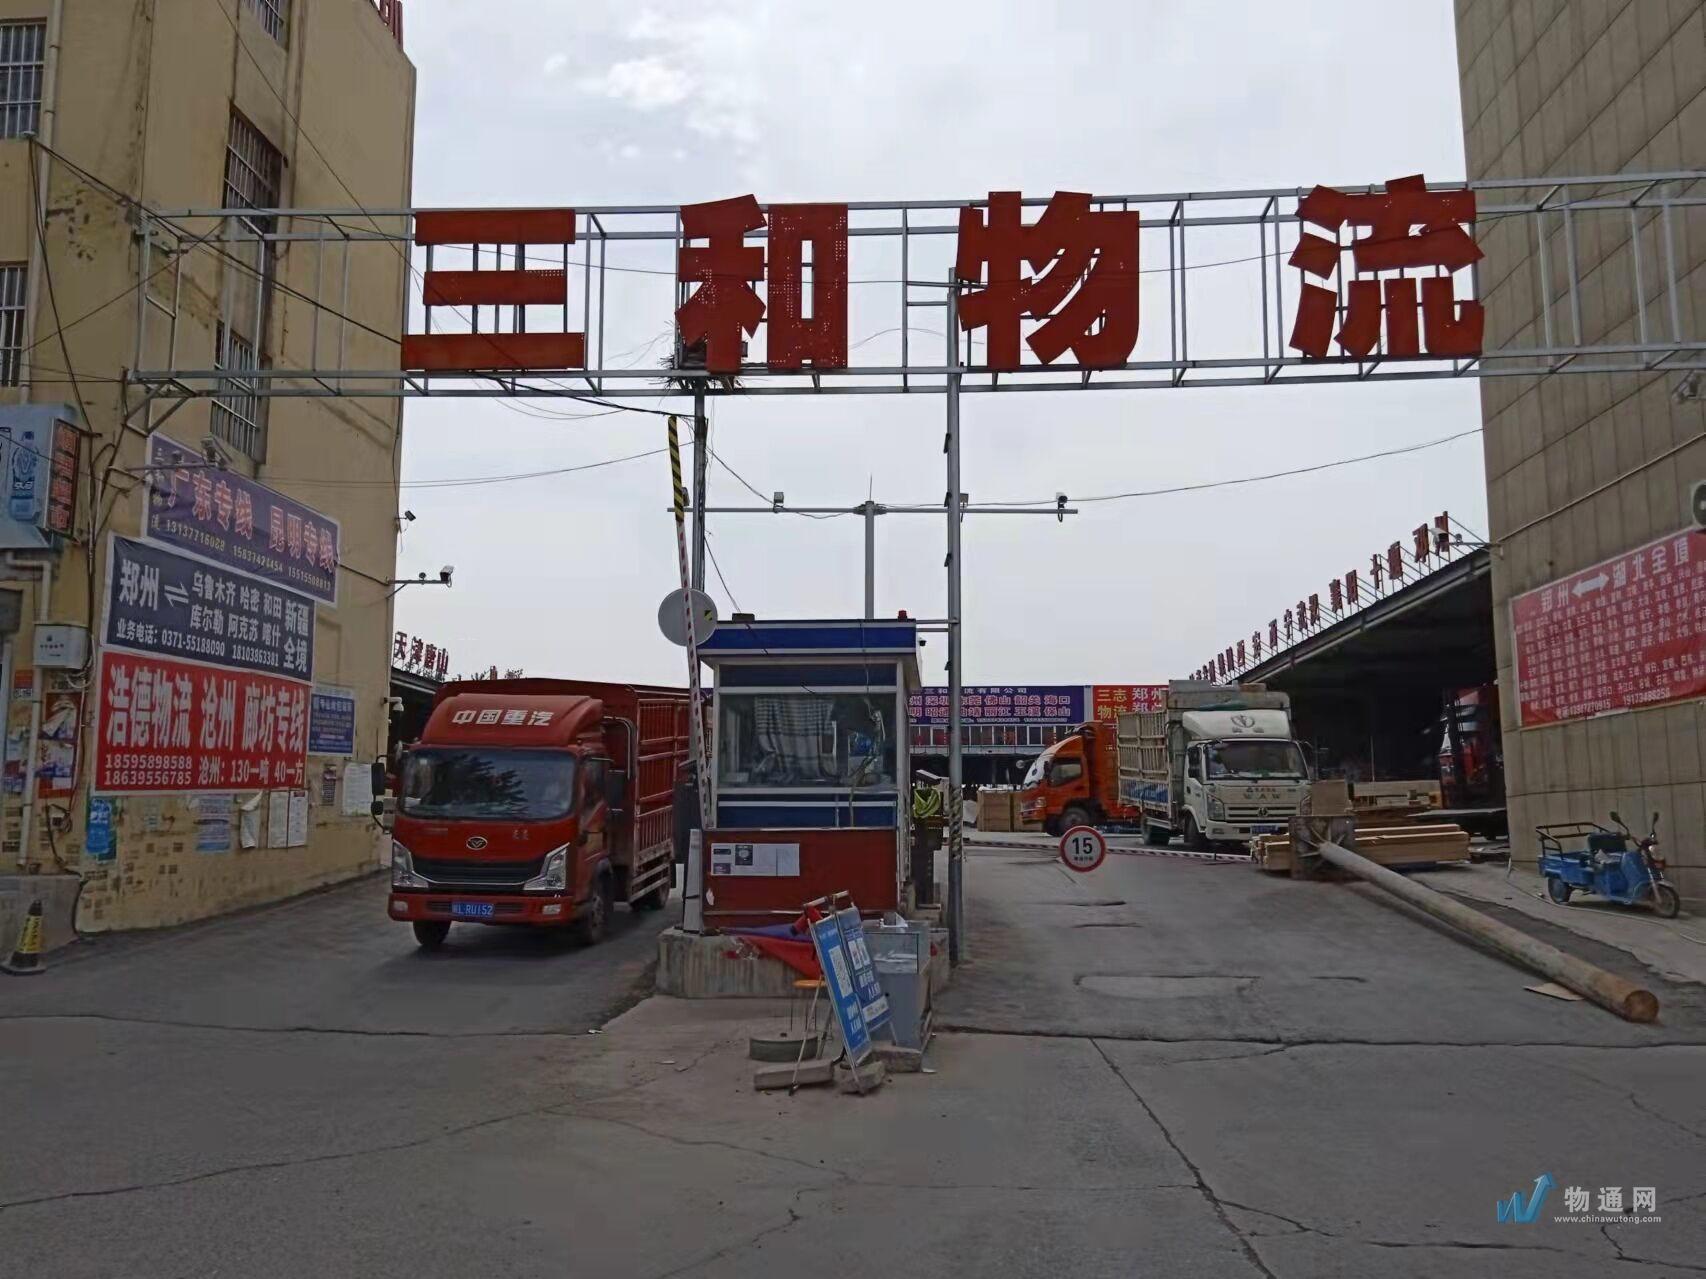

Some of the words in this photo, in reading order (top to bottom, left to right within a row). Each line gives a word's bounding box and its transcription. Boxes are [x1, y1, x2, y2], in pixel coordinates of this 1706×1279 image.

[403, 174, 1485, 374] 三和物流
[119, 557, 160, 611] 郑州
[191, 570, 236, 607] 乌鲁木齐
[239, 585, 260, 613] 哈密
[263, 592, 282, 619] 和田
[285, 600, 309, 637] 新疆
[161, 628, 225, 657] 0371-55188090
[189, 603, 223, 635] 库尔勒
[227, 613, 259, 642] 阿克苏
[262, 624, 281, 648] 喀什
[283, 637, 307, 673] 全境
[394, 630, 449, 675] 天津唐山
[106, 664, 193, 748] 浩德物流
[200, 671, 237, 751] 沧州
[241, 681, 305, 753] 廊坊专线
[1097, 688, 1127, 702] 三志
[1132, 702, 1162, 713] 郑
[452, 709, 554, 726] 中国重汽
[105, 753, 193, 769] 18595898588
[104, 770, 191, 785] 18639556785
[1072, 837, 1093, 854] 15
